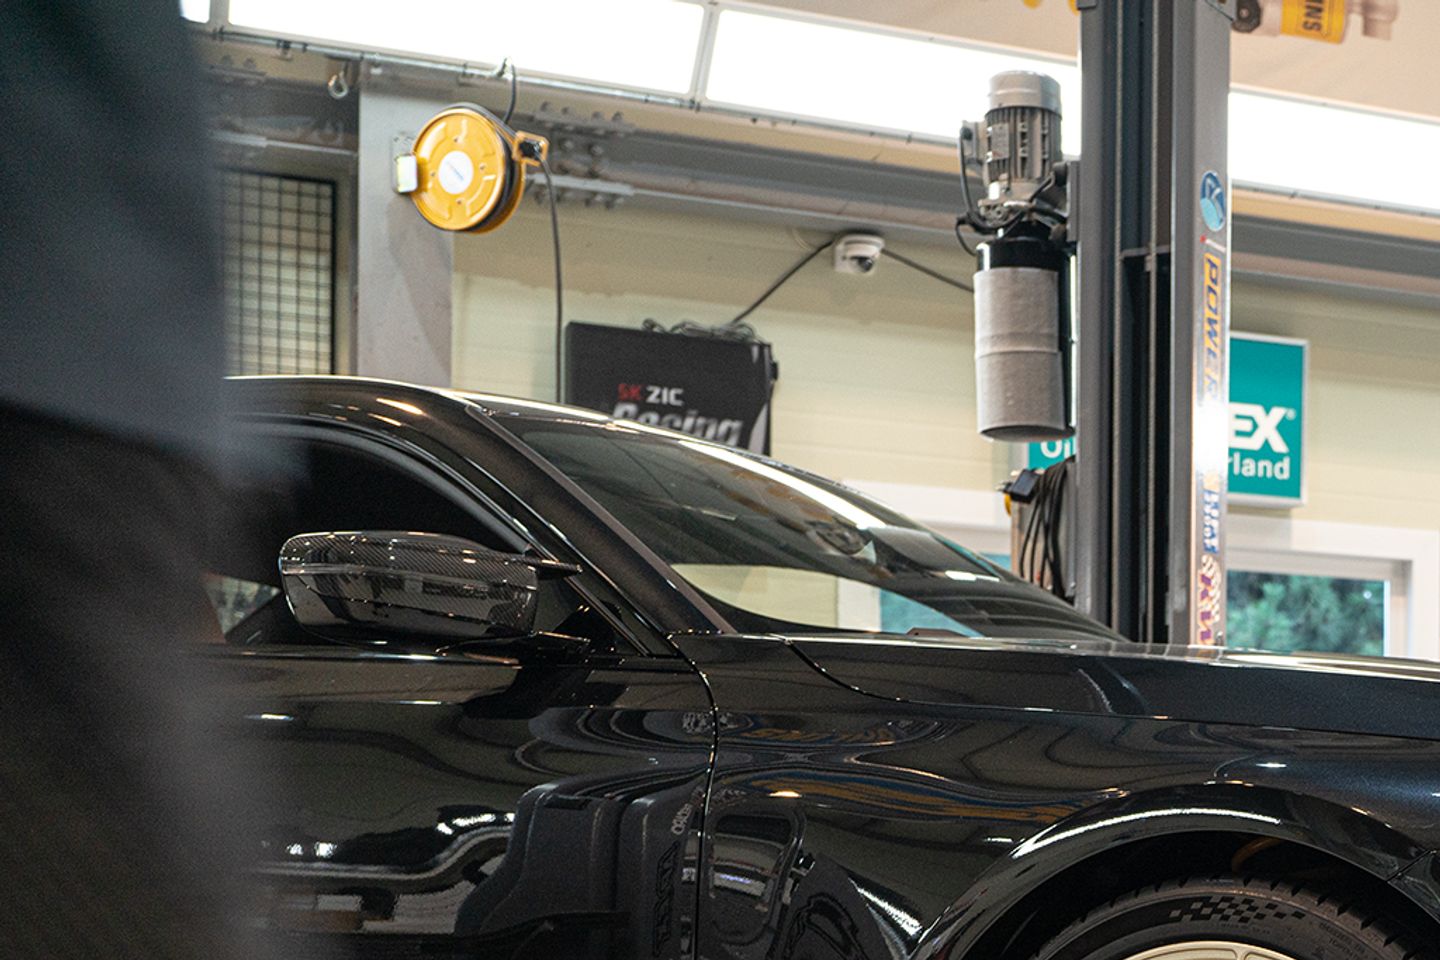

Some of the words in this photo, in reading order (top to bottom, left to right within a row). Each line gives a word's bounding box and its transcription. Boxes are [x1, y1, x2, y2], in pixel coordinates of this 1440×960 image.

[645, 385, 685, 407] ZIC
[1229, 402, 1290, 454] EX
[1229, 452, 1290, 480] land
